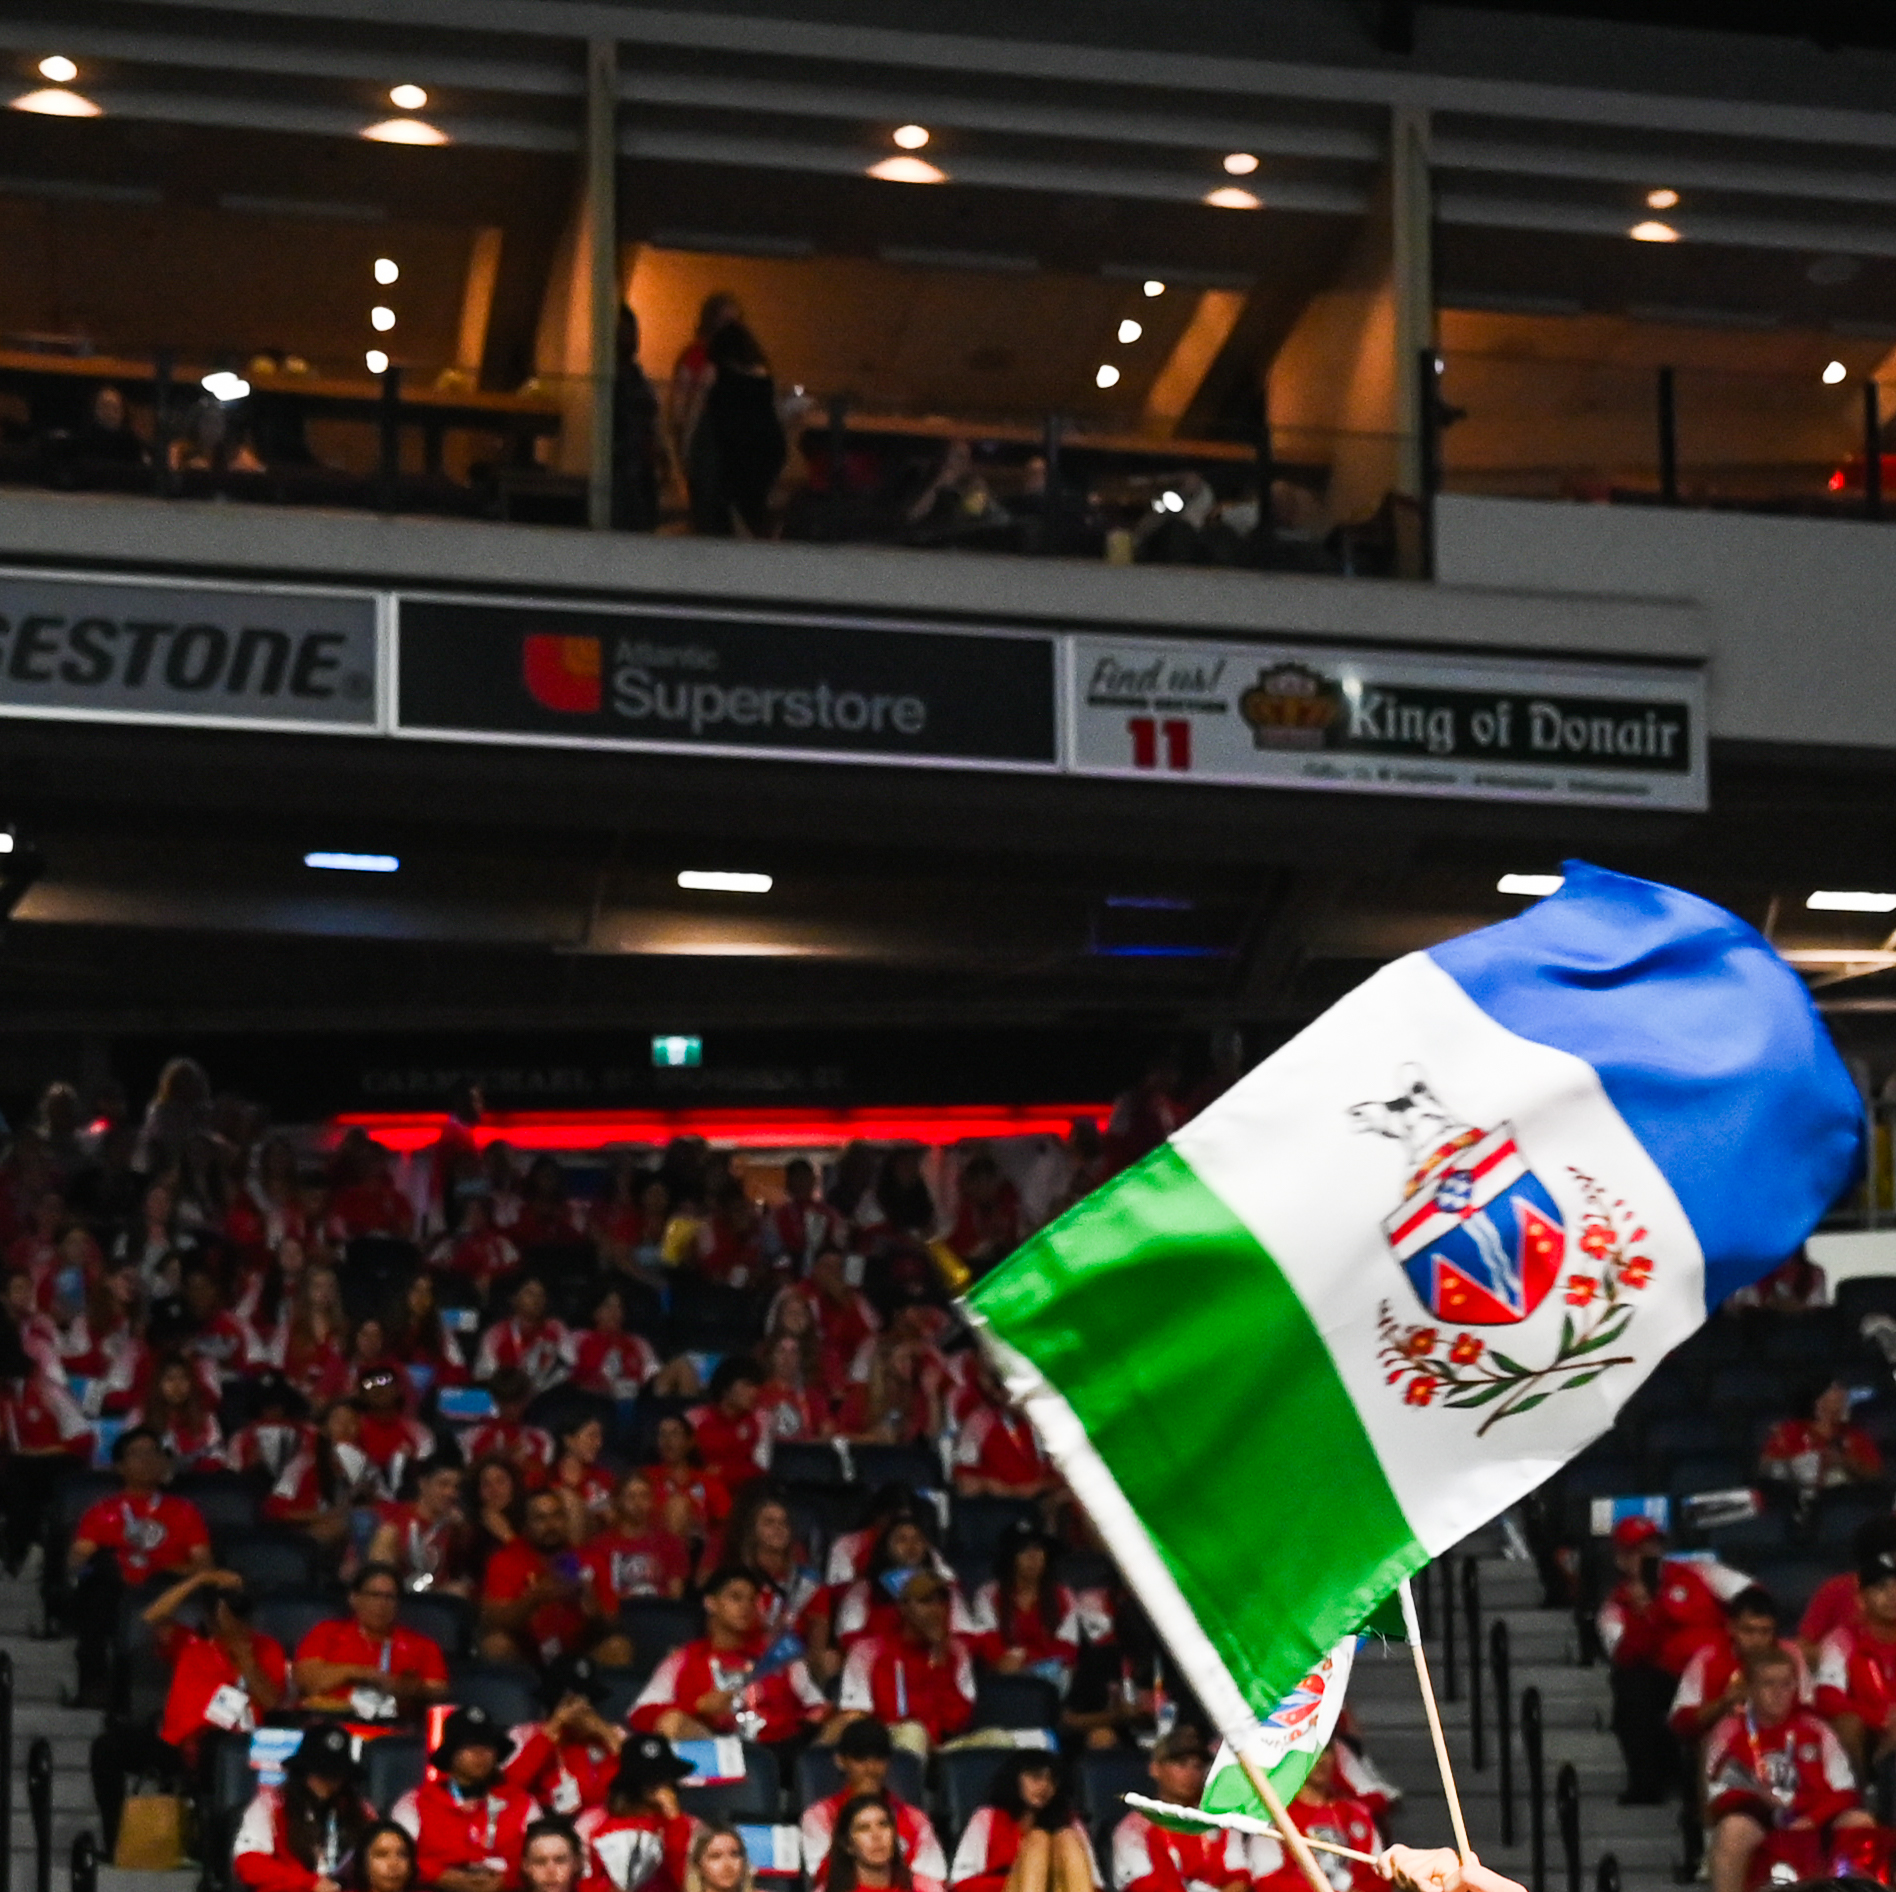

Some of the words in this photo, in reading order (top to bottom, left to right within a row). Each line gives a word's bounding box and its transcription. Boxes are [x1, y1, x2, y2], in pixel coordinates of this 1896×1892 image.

[613, 666, 927, 735] Superstore
[1347, 694, 1454, 753] King
[1529, 701, 1681, 758] Donair
[1127, 717, 1191, 772] 11
